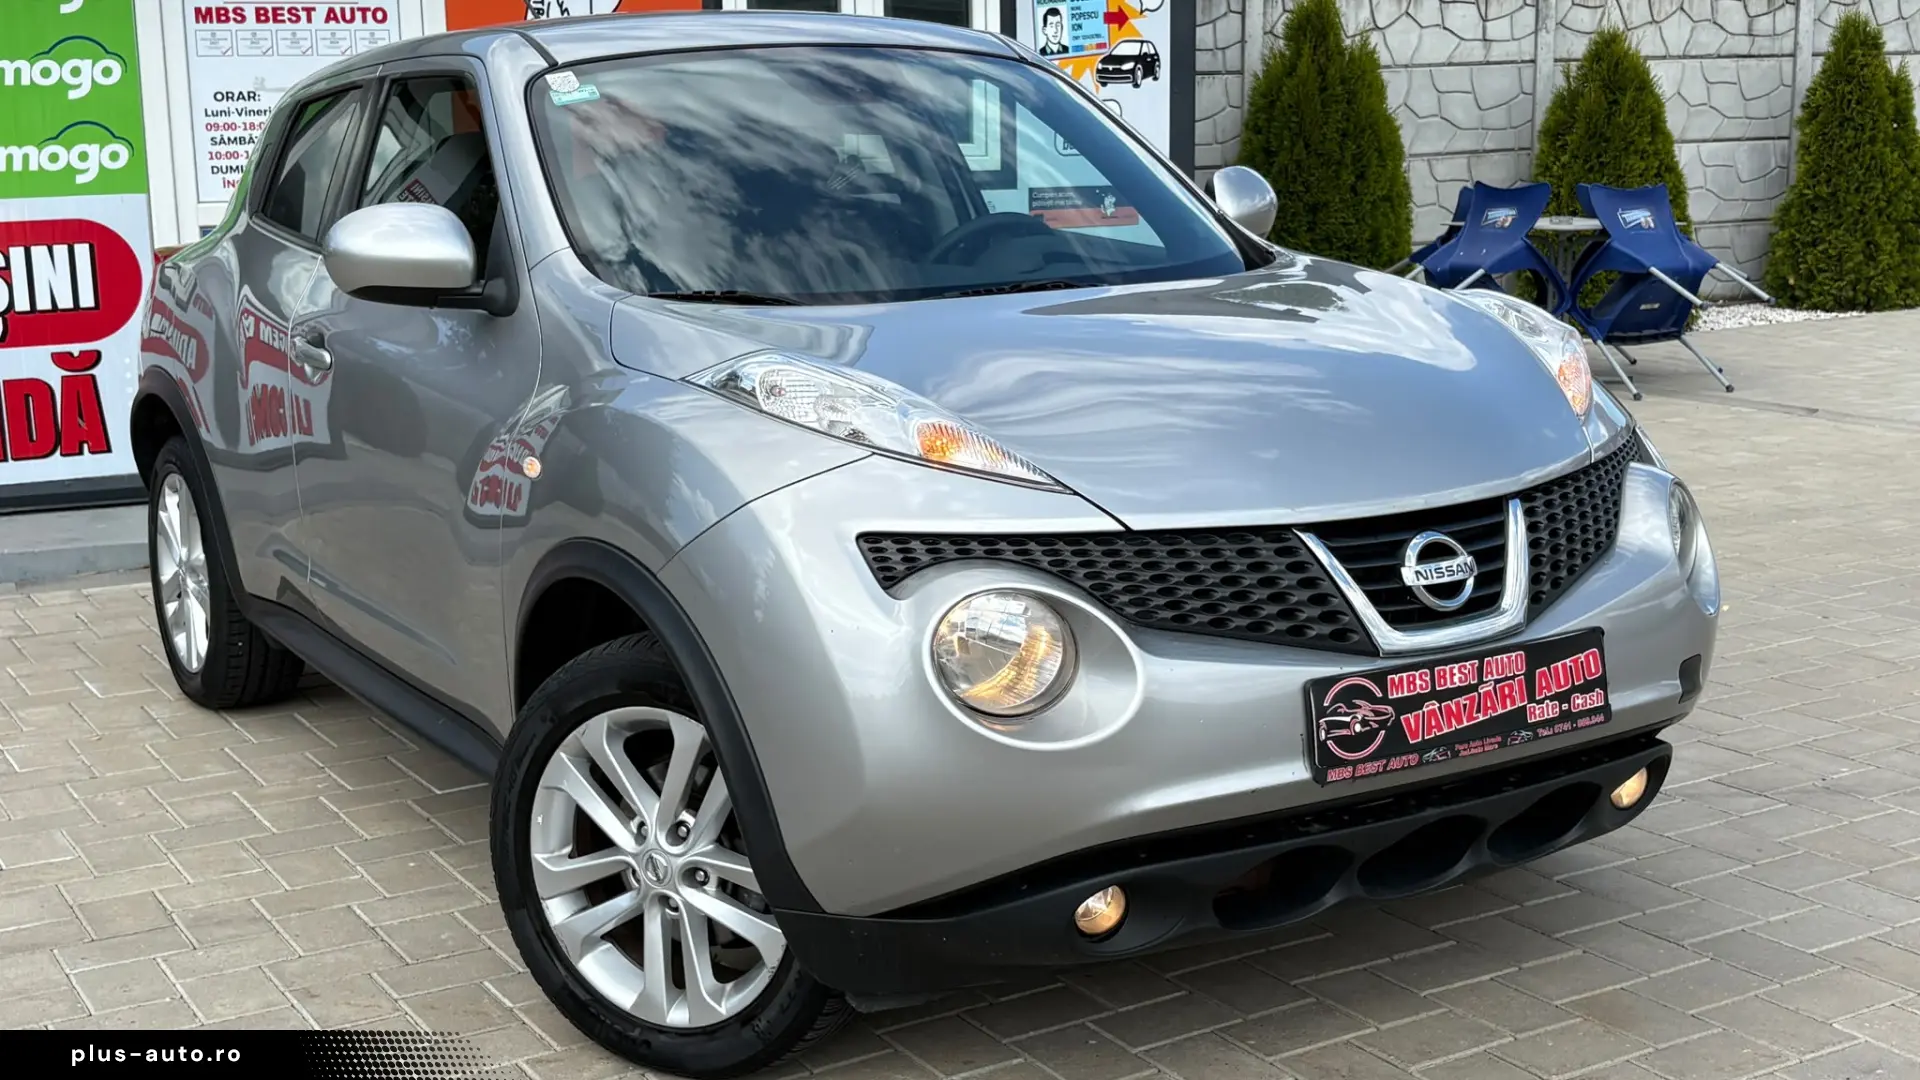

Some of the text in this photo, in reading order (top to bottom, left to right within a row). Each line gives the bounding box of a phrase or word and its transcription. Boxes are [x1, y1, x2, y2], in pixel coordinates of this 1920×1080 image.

[194, 6, 388, 25] MBS BEST AUTO
[1070, 11, 1099, 21] POPESCU
[1071, 23, 1083, 31] ION
[0, 58, 122, 100] mogo
[213, 90, 262, 102] ORAR:
[204, 106, 272, 118] Luni-Vineri
[210, 134, 258, 146] SÂMBĂ
[0, 143, 129, 185] mogo
[0, 349, 113, 463] DĂ
[1414, 561, 1475, 582] NISSAN
[1387, 651, 1527, 699] MBS BEST AUTO
[1536, 647, 1602, 699] AUTO
[1527, 701, 1559, 723] Rate
[1570, 688, 1604, 713] Cash
[1326, 753, 1420, 782] MBS BEST AUTO
